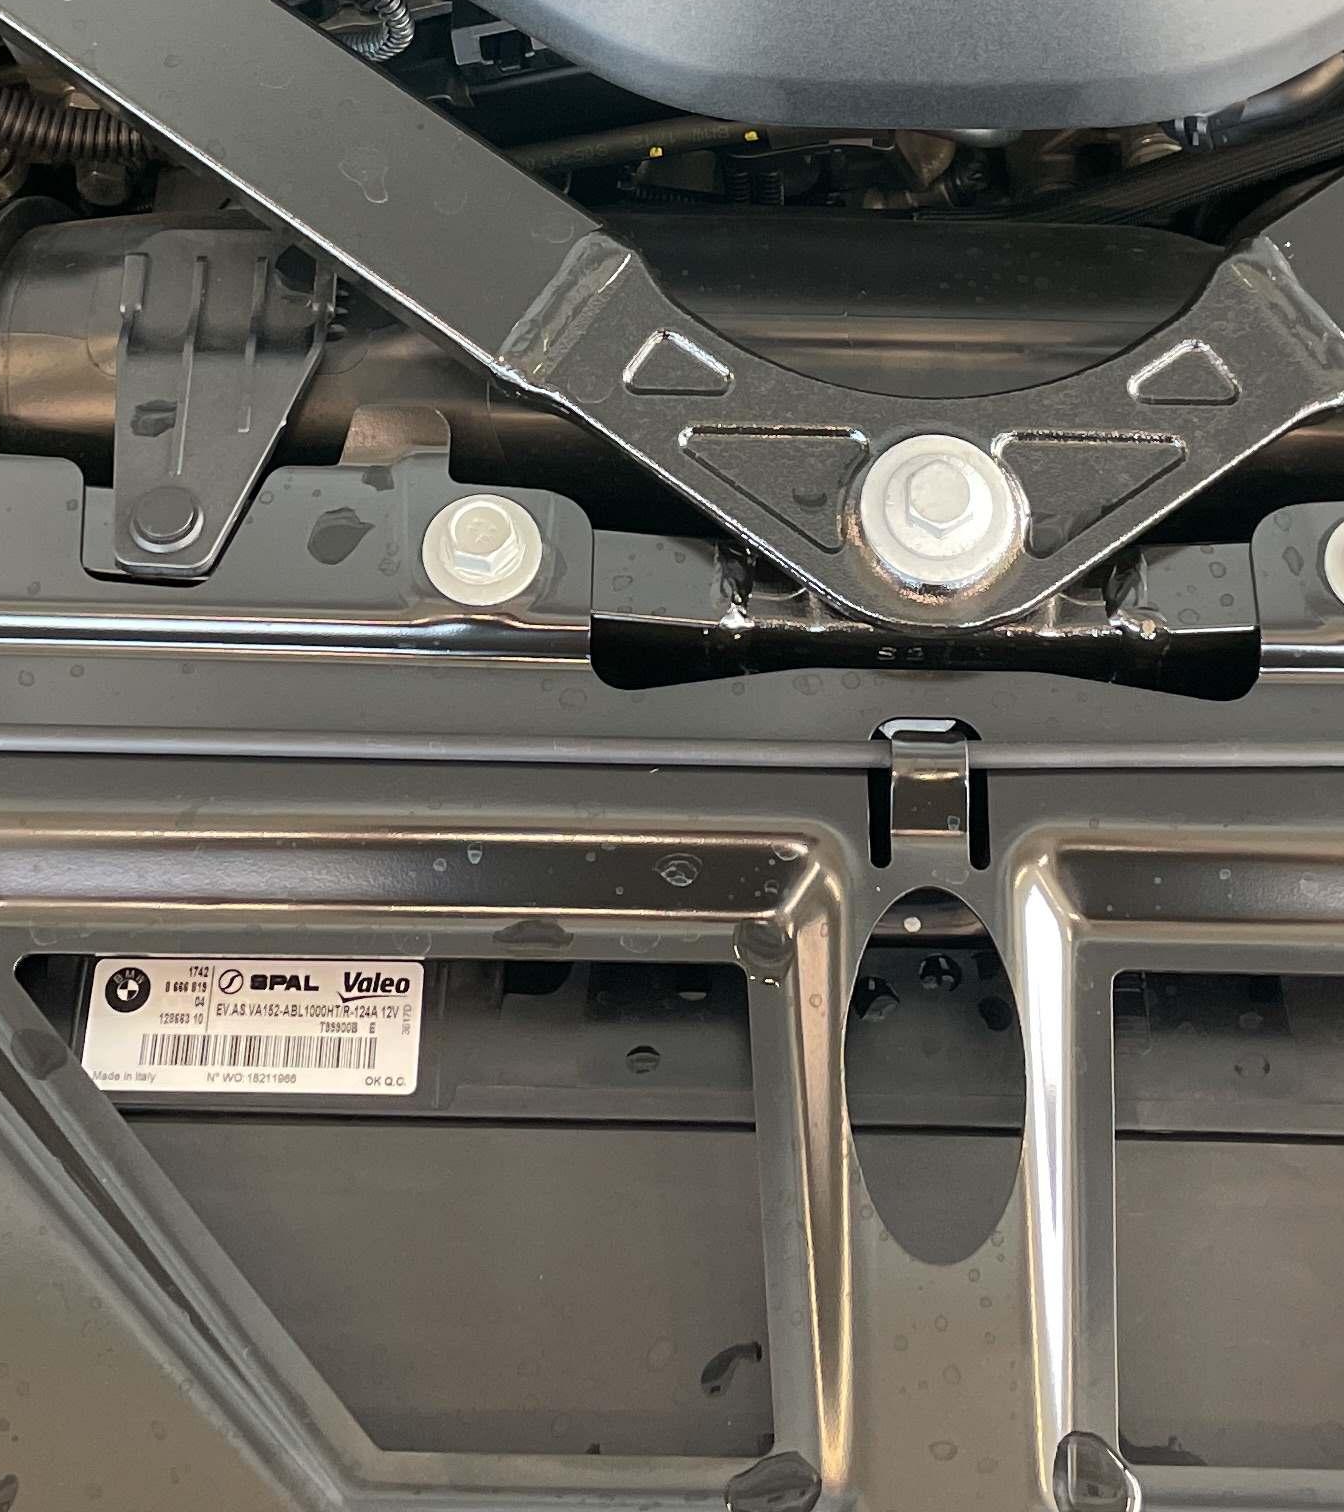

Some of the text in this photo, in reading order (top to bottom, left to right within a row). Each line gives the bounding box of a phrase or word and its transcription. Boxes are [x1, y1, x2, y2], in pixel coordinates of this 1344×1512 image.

[189, 965, 210, 978] 1742
[249, 973, 320, 992] SPAL
[343, 970, 411, 994] Valeo
[382, 1005, 400, 1020] 12V
[92, 1070, 121, 1082] Made
[135, 1071, 157, 1084] Italy
[364, 1075, 382, 1087] OK
